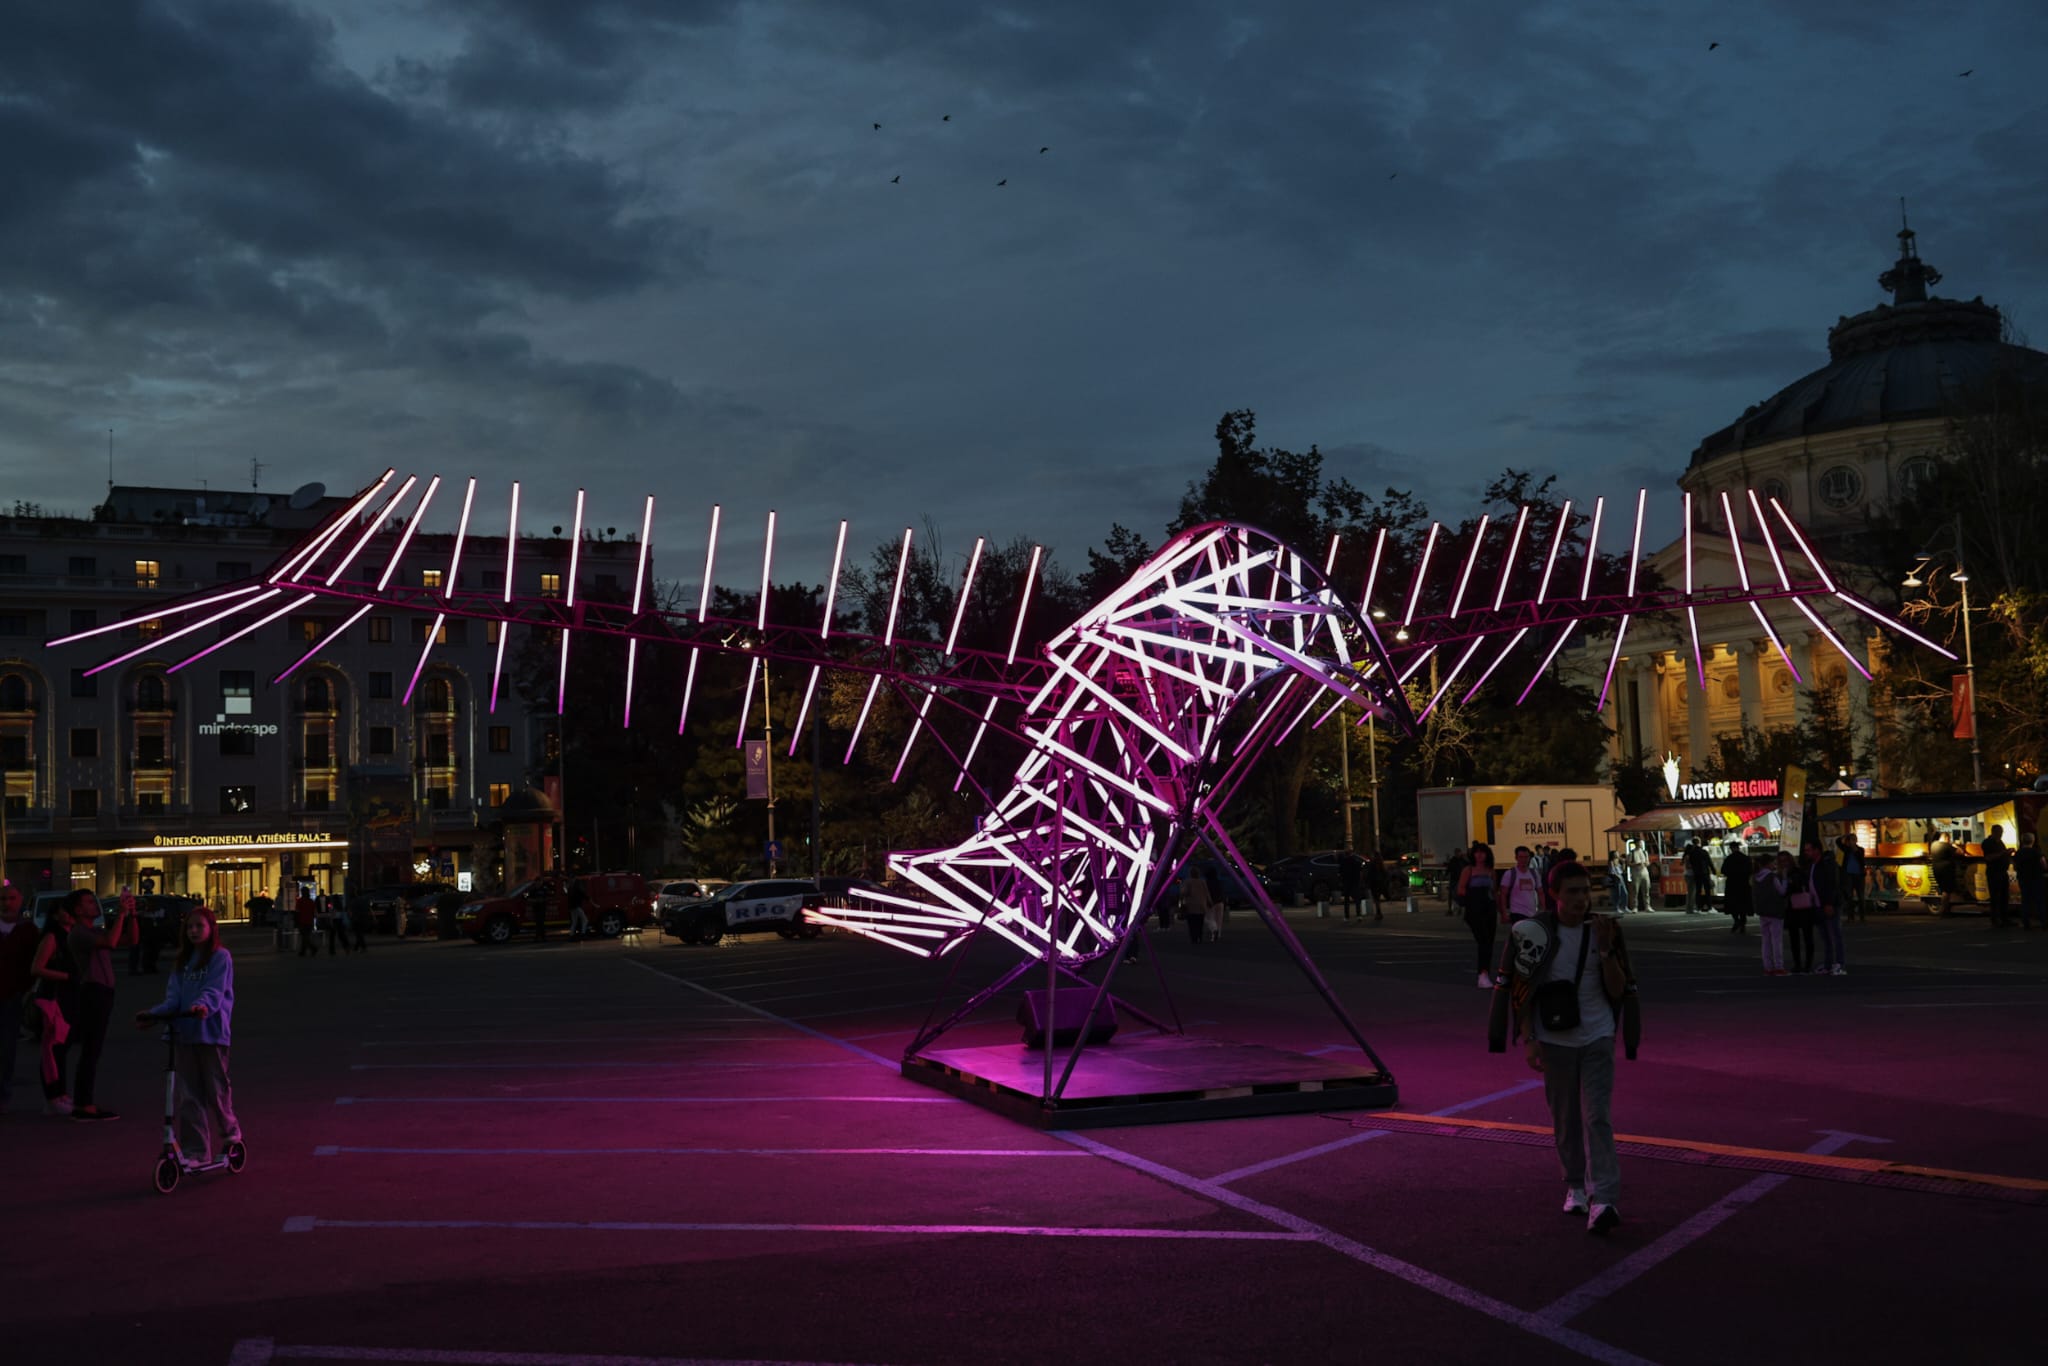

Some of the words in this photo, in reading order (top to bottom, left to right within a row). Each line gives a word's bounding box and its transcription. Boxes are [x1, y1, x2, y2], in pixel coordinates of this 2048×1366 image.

[199, 722, 278, 737] mindscape
[1680, 783, 1715, 801] TASTE
[1715, 781, 1730, 799] OF
[1730, 779, 1778, 798] BELGIUM
[1525, 821, 1565, 835] FRAIKIN
[163, 834, 254, 846] INTERCONTINENTAL
[256, 832, 297, 844] ATHÉNÉE
[736, 905, 785, 918] RPG
